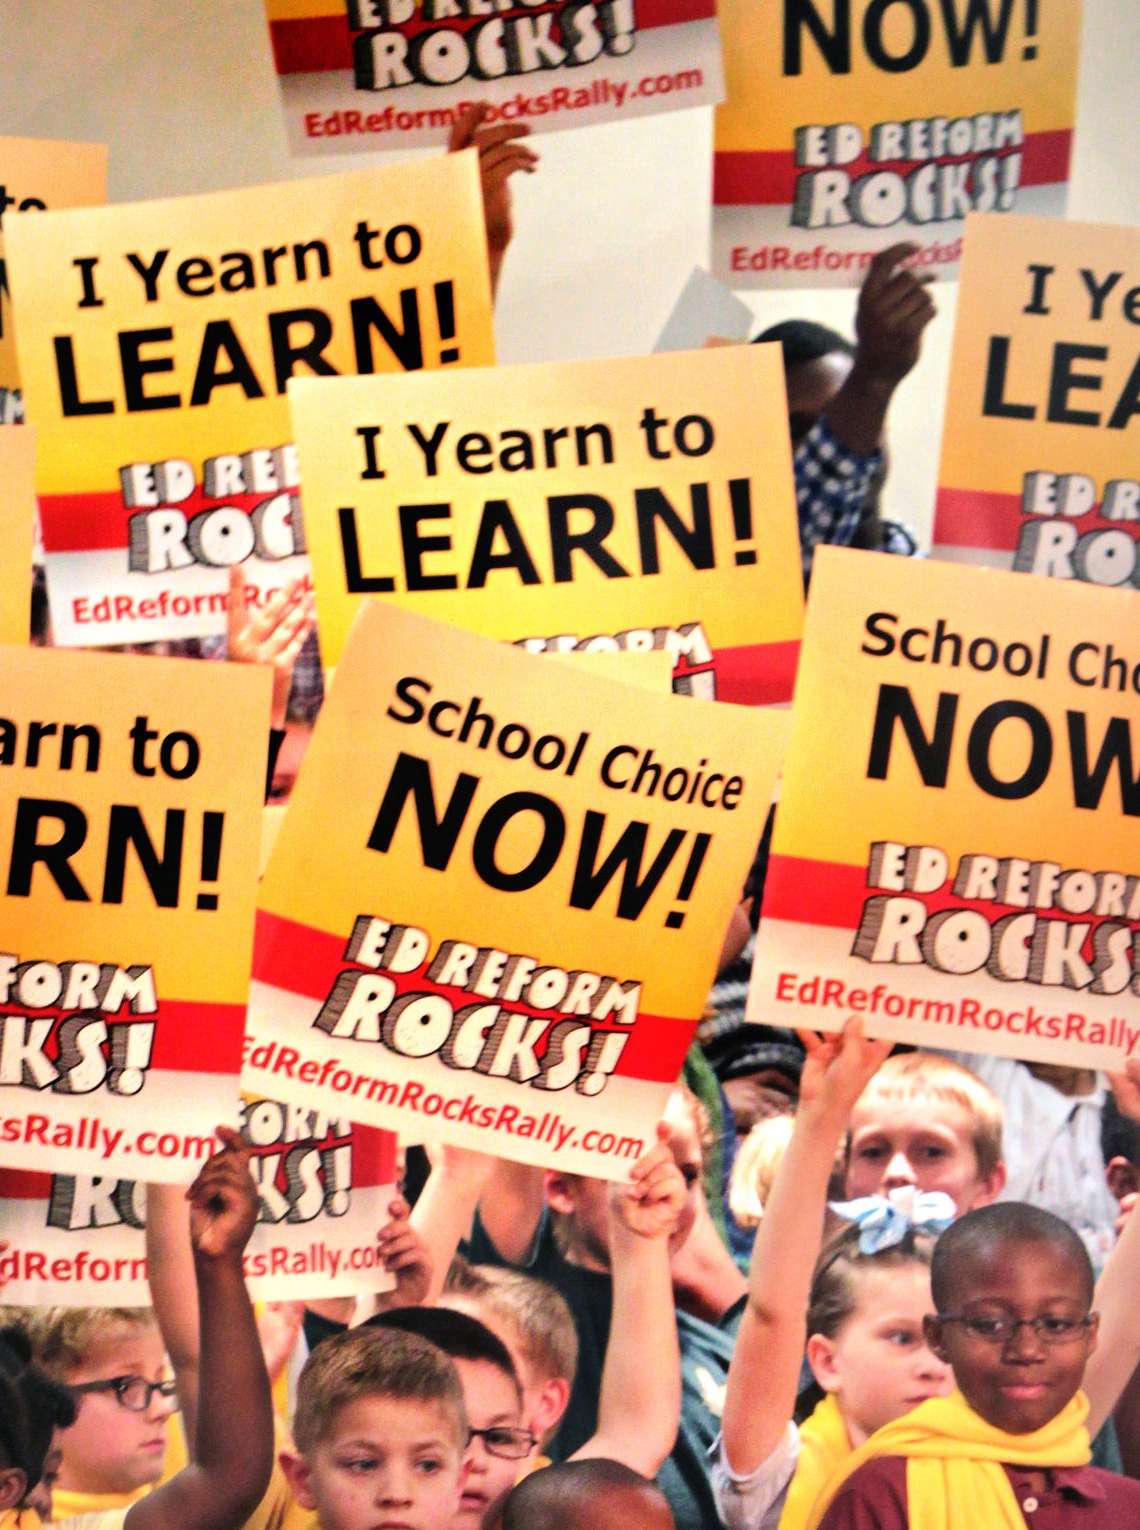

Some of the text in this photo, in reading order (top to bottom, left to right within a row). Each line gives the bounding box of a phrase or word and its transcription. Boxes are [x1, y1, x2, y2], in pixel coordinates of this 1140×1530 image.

[353, 0, 636, 91] ROCKS!
[781, 0, 1040, 76] NOW!
[795, 109, 1024, 168] ED REFORM
[790, 152, 1023, 230] ROCKS!
[73, 220, 423, 308] I Yearn to
[1022, 264, 1054, 316] I
[53, 280, 461, 419] LEARN!
[356, 407, 716, 480] I Yearn to
[119, 463, 196, 509] ED
[1022, 470, 1096, 517] ED
[337, 478, 758, 593] LEARN!
[861, 612, 1050, 679] School
[130, 716, 201, 780] to
[385, 676, 745, 810] School Choice
[366, 751, 712, 930] NOW!
[866, 841, 1140, 921] ED REFOR
[343, 914, 642, 1024] ED REFORM
[312, 968, 632, 1096] ROCKS!
